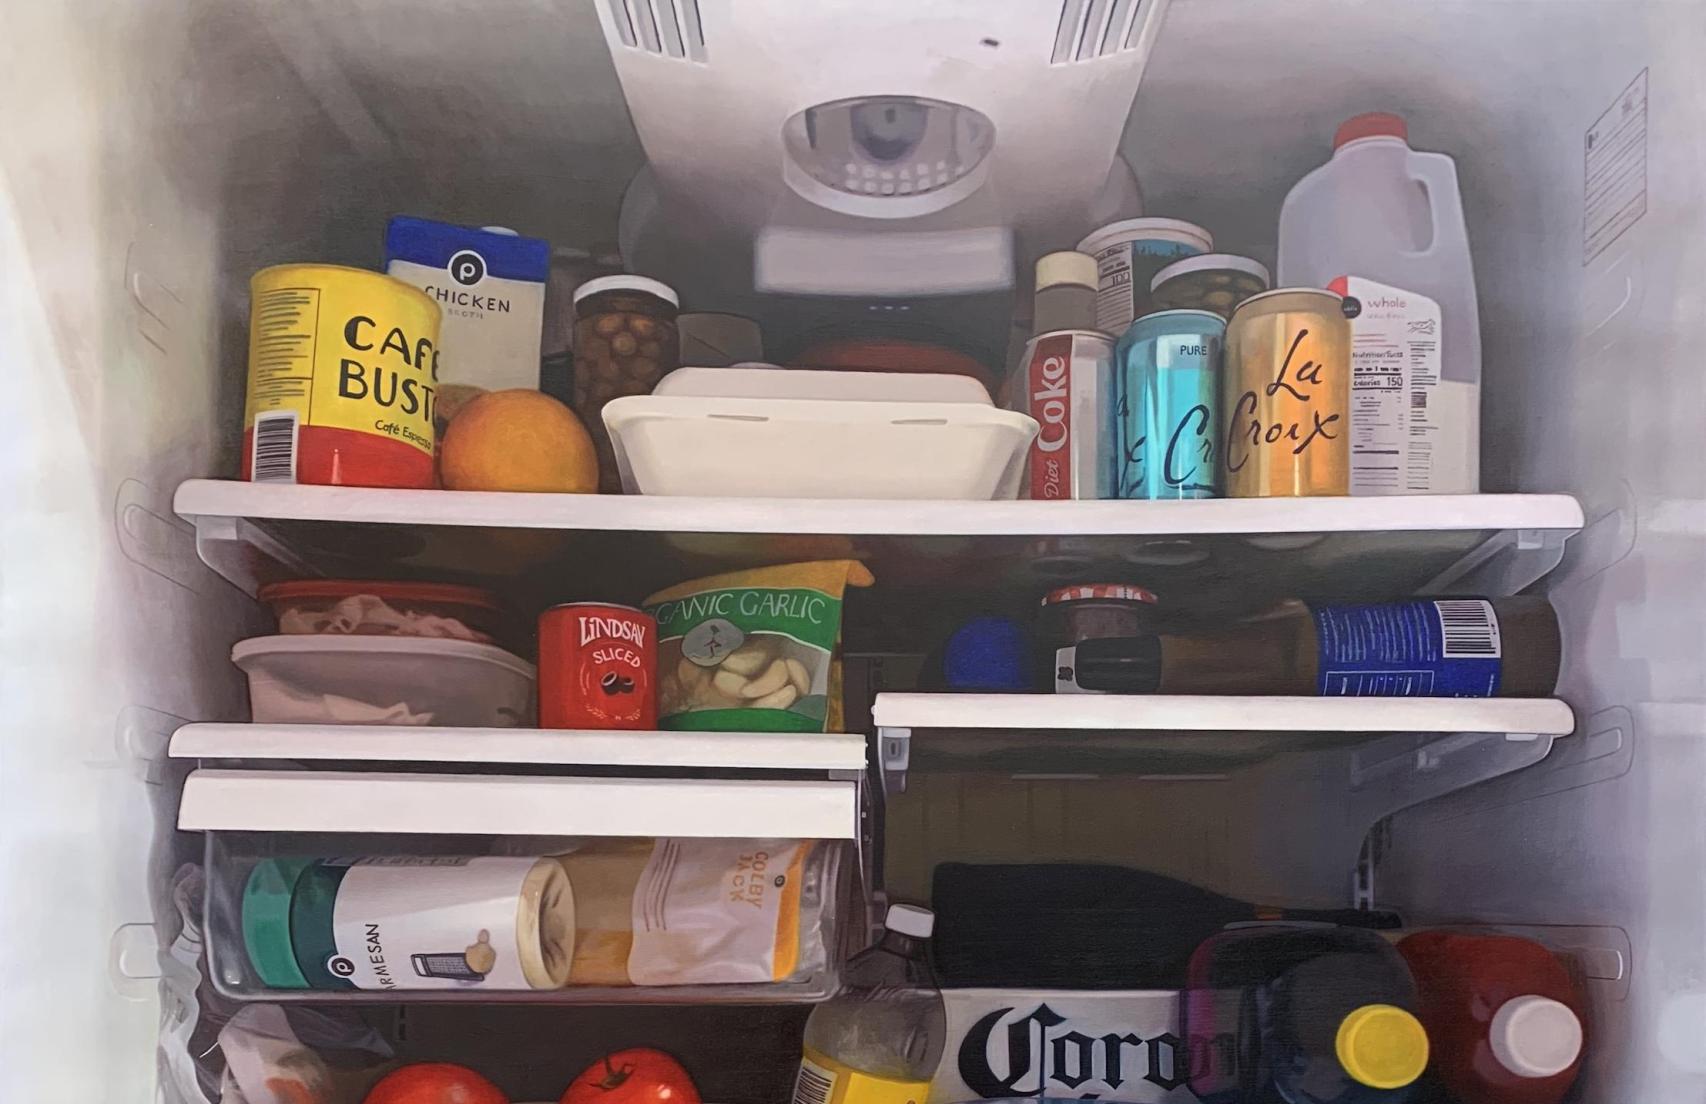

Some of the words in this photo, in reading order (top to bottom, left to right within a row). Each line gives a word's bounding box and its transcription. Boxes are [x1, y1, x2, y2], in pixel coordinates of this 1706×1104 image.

[425, 285, 511, 313] CHICKEN
[1367, 297, 1407, 308] whole
[1179, 344, 1207, 356] PURE
[1266, 329, 1323, 402] La
[338, 358, 438, 426] BUST
[1387, 376, 1403, 387] 150
[1034, 355, 1067, 452] Coke
[1227, 391, 1340, 473] Croix
[1043, 459, 1060, 498] Diet
[648, 592, 733, 625] GANIC
[740, 591, 826, 624] GARLIC
[592, 647, 641, 668] SLICED
[746, 851, 769, 910] COLBY
